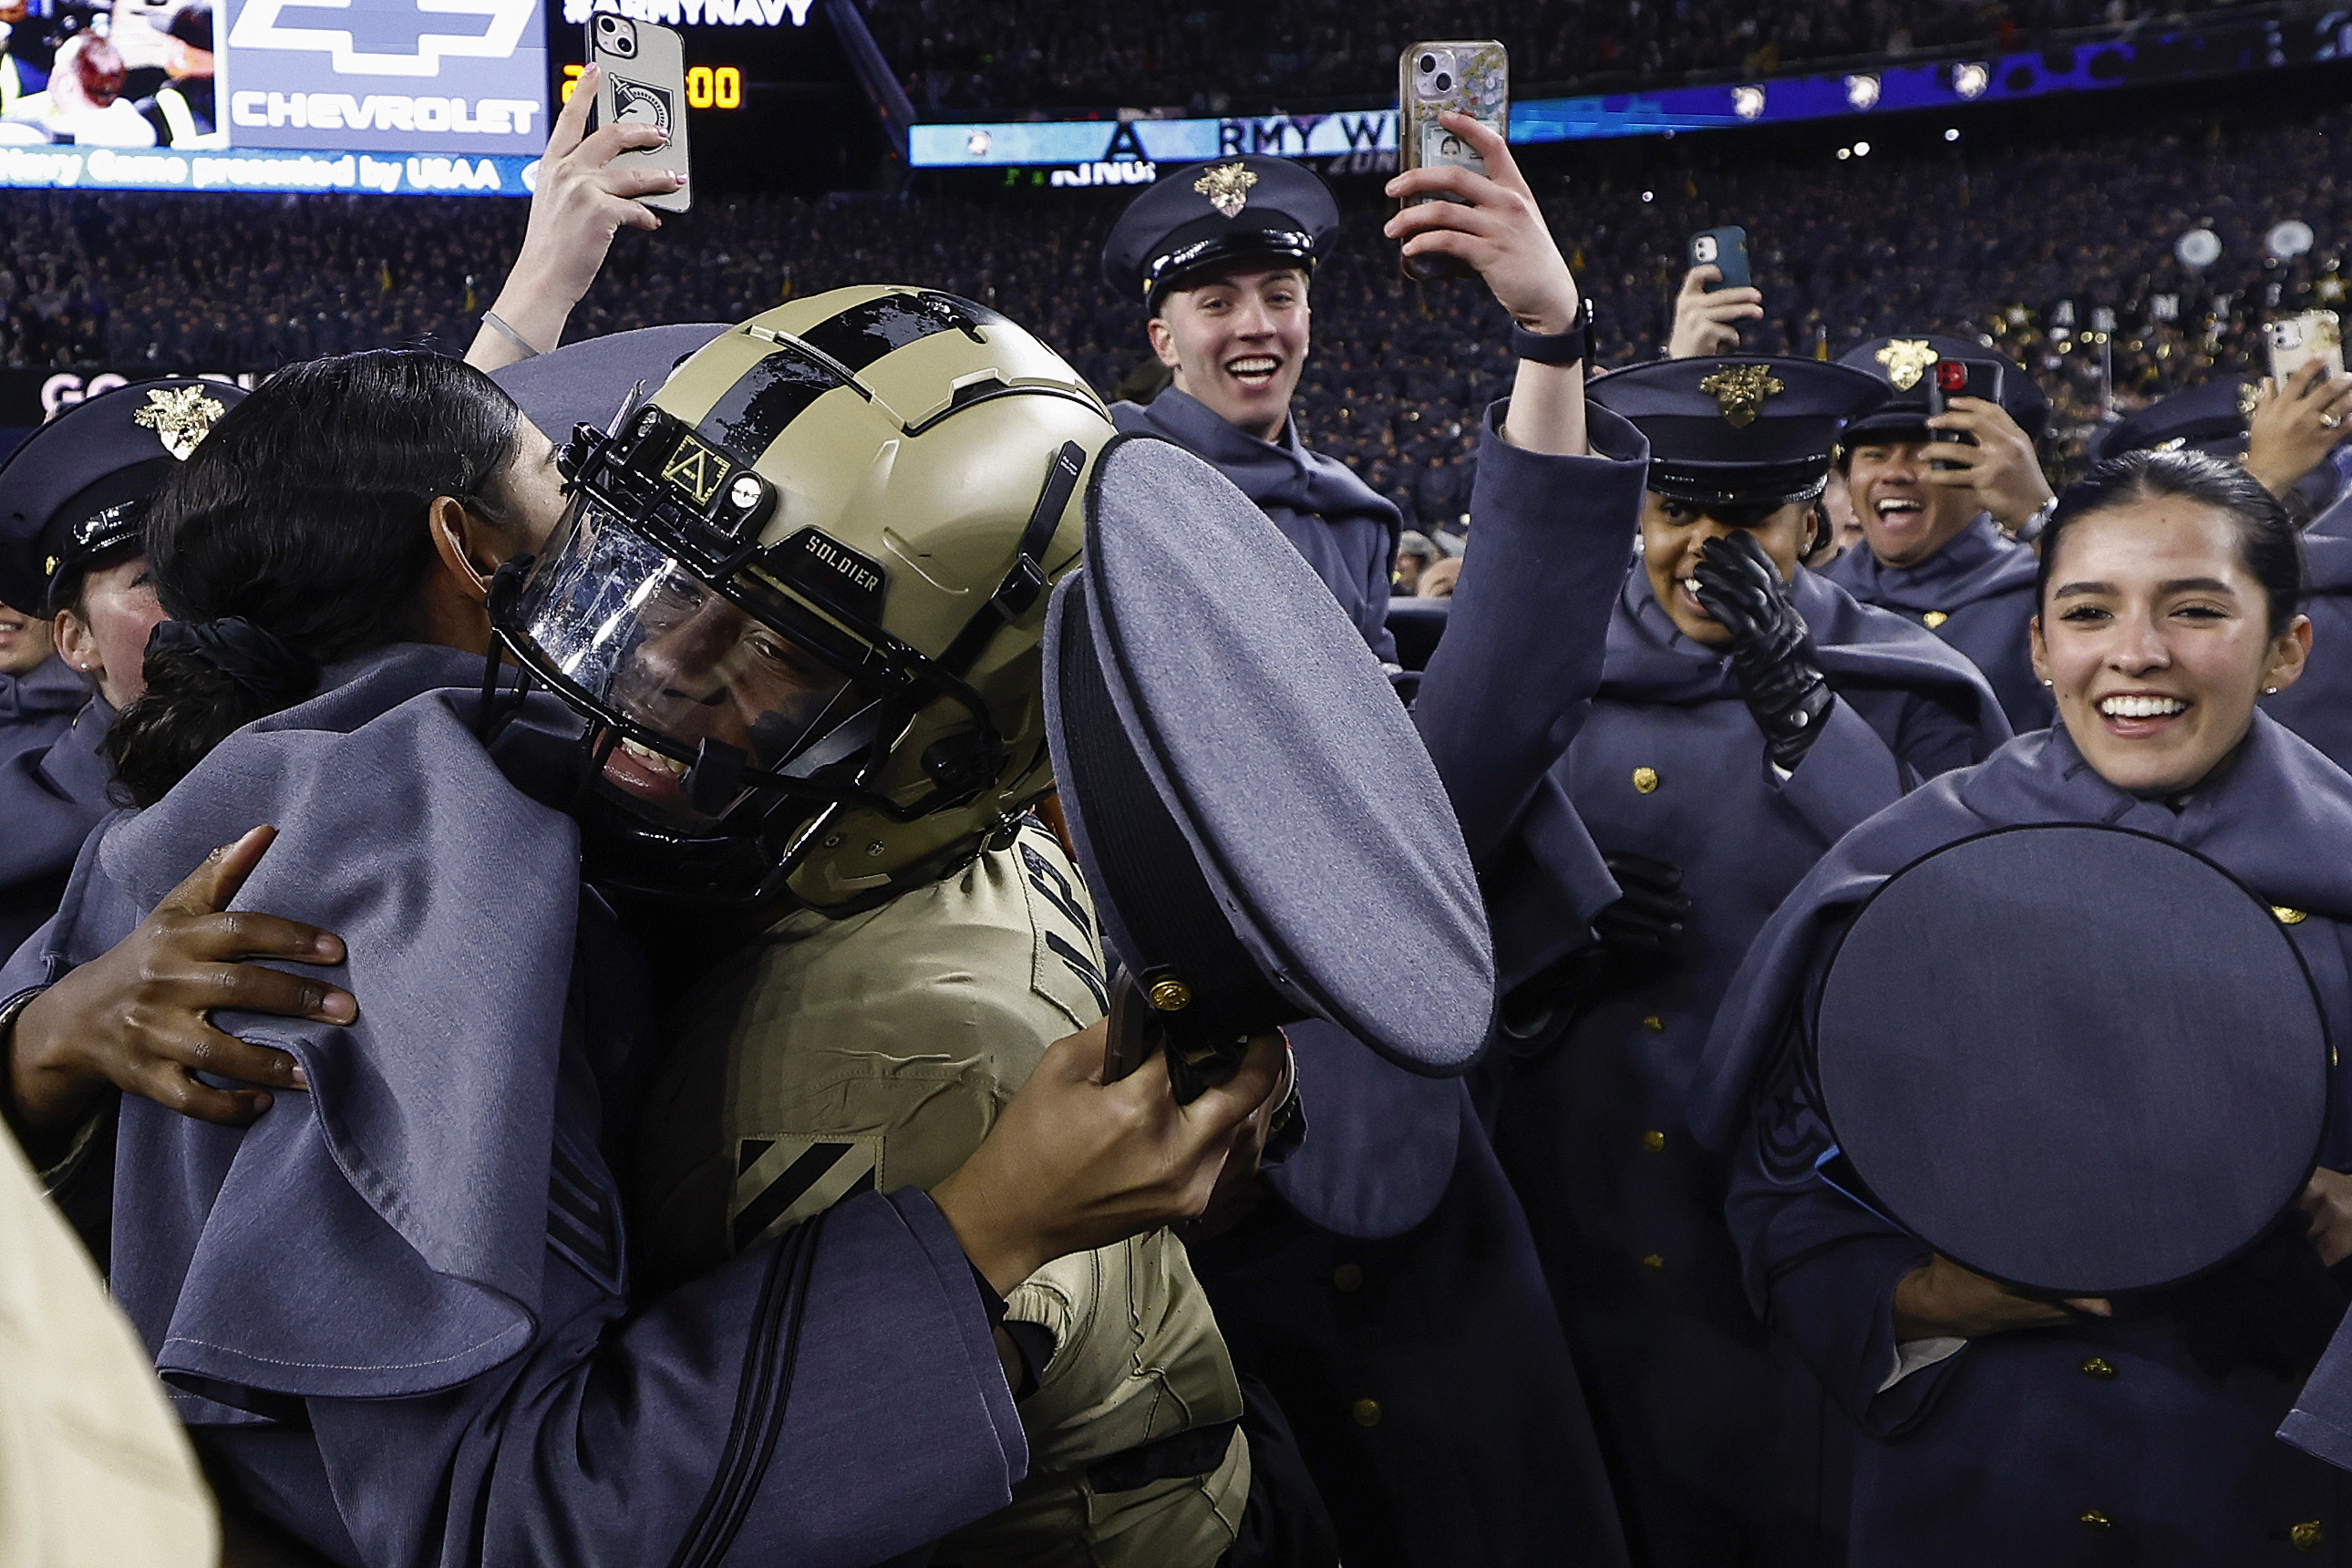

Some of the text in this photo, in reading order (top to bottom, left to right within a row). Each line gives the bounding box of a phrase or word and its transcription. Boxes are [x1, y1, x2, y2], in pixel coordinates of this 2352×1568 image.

[232, 91, 540, 134] CHEVROLET
[88, 149, 188, 183] Game
[192, 155, 356, 188] presented
[359, 155, 403, 192] by
[407, 158, 501, 191] USAA
[805, 535, 879, 592] SOLDIER
